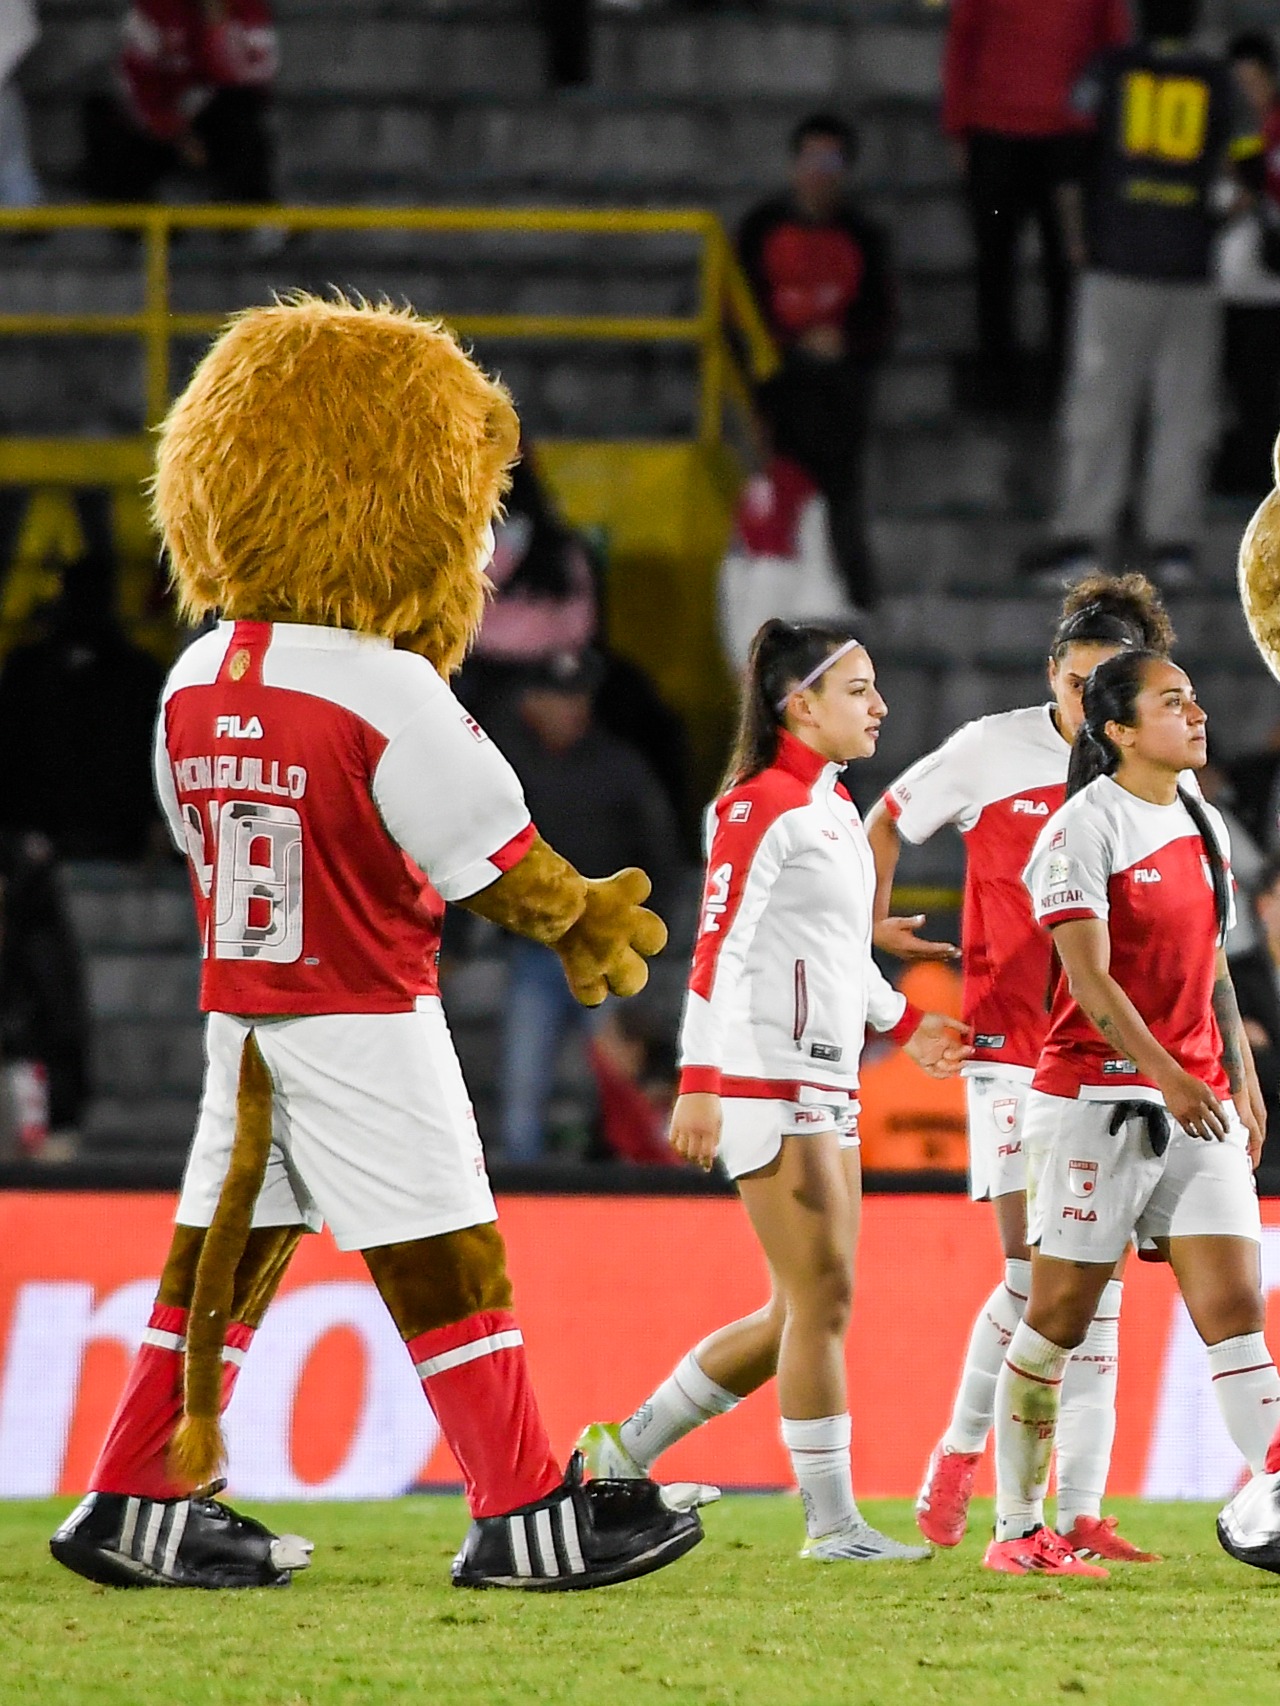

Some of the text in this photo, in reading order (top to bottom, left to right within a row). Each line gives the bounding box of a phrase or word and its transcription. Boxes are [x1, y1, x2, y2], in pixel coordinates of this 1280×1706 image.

[1124, 72, 1207, 160] 10
[216, 715, 263, 739] FILA
[1013, 799, 1050, 816] FILA
[1133, 868, 1162, 883] FILA
[1041, 889, 1084, 909] NECTAR
[1062, 1206, 1098, 1222] FILA
